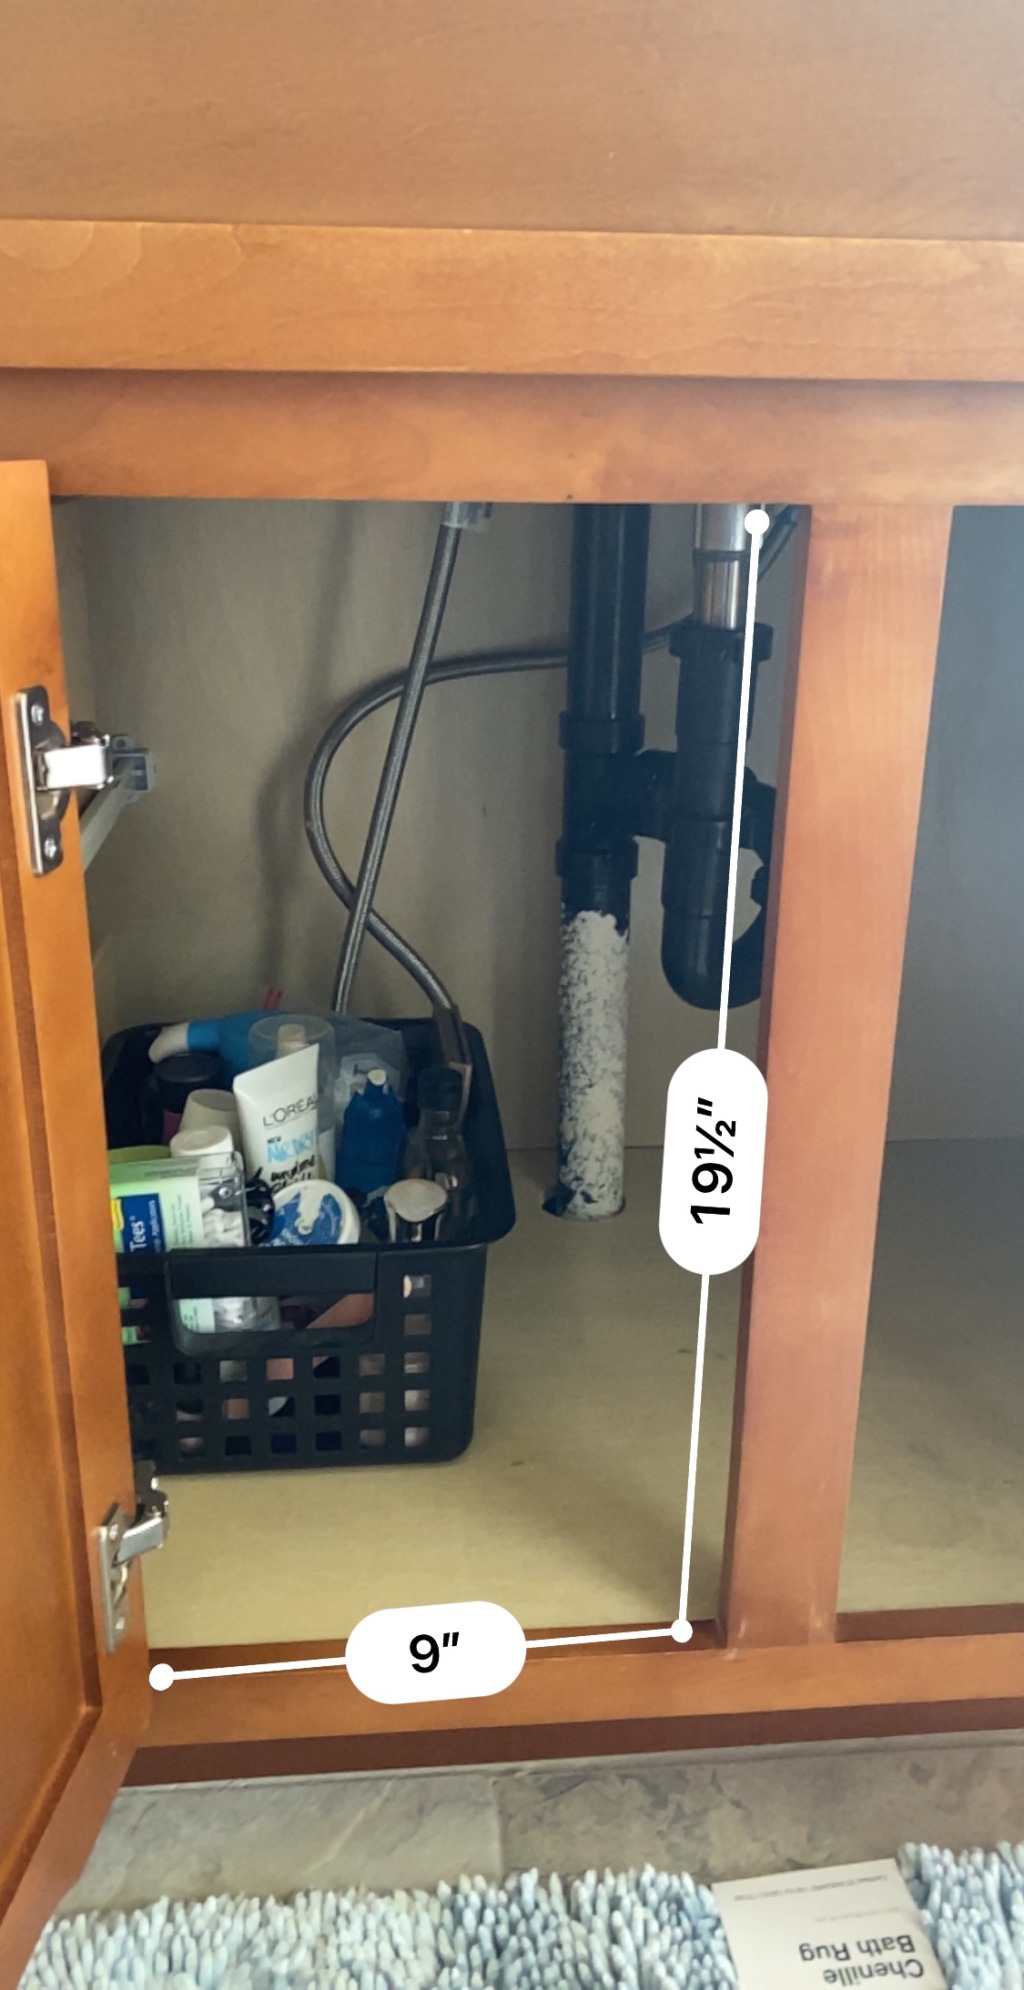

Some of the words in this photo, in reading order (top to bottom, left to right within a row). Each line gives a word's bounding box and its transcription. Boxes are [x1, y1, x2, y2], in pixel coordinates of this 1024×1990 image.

[798, 1942, 852, 1962] Rug
[856, 1934, 916, 1958] Bath
[822, 1958, 925, 1987] Chenille
